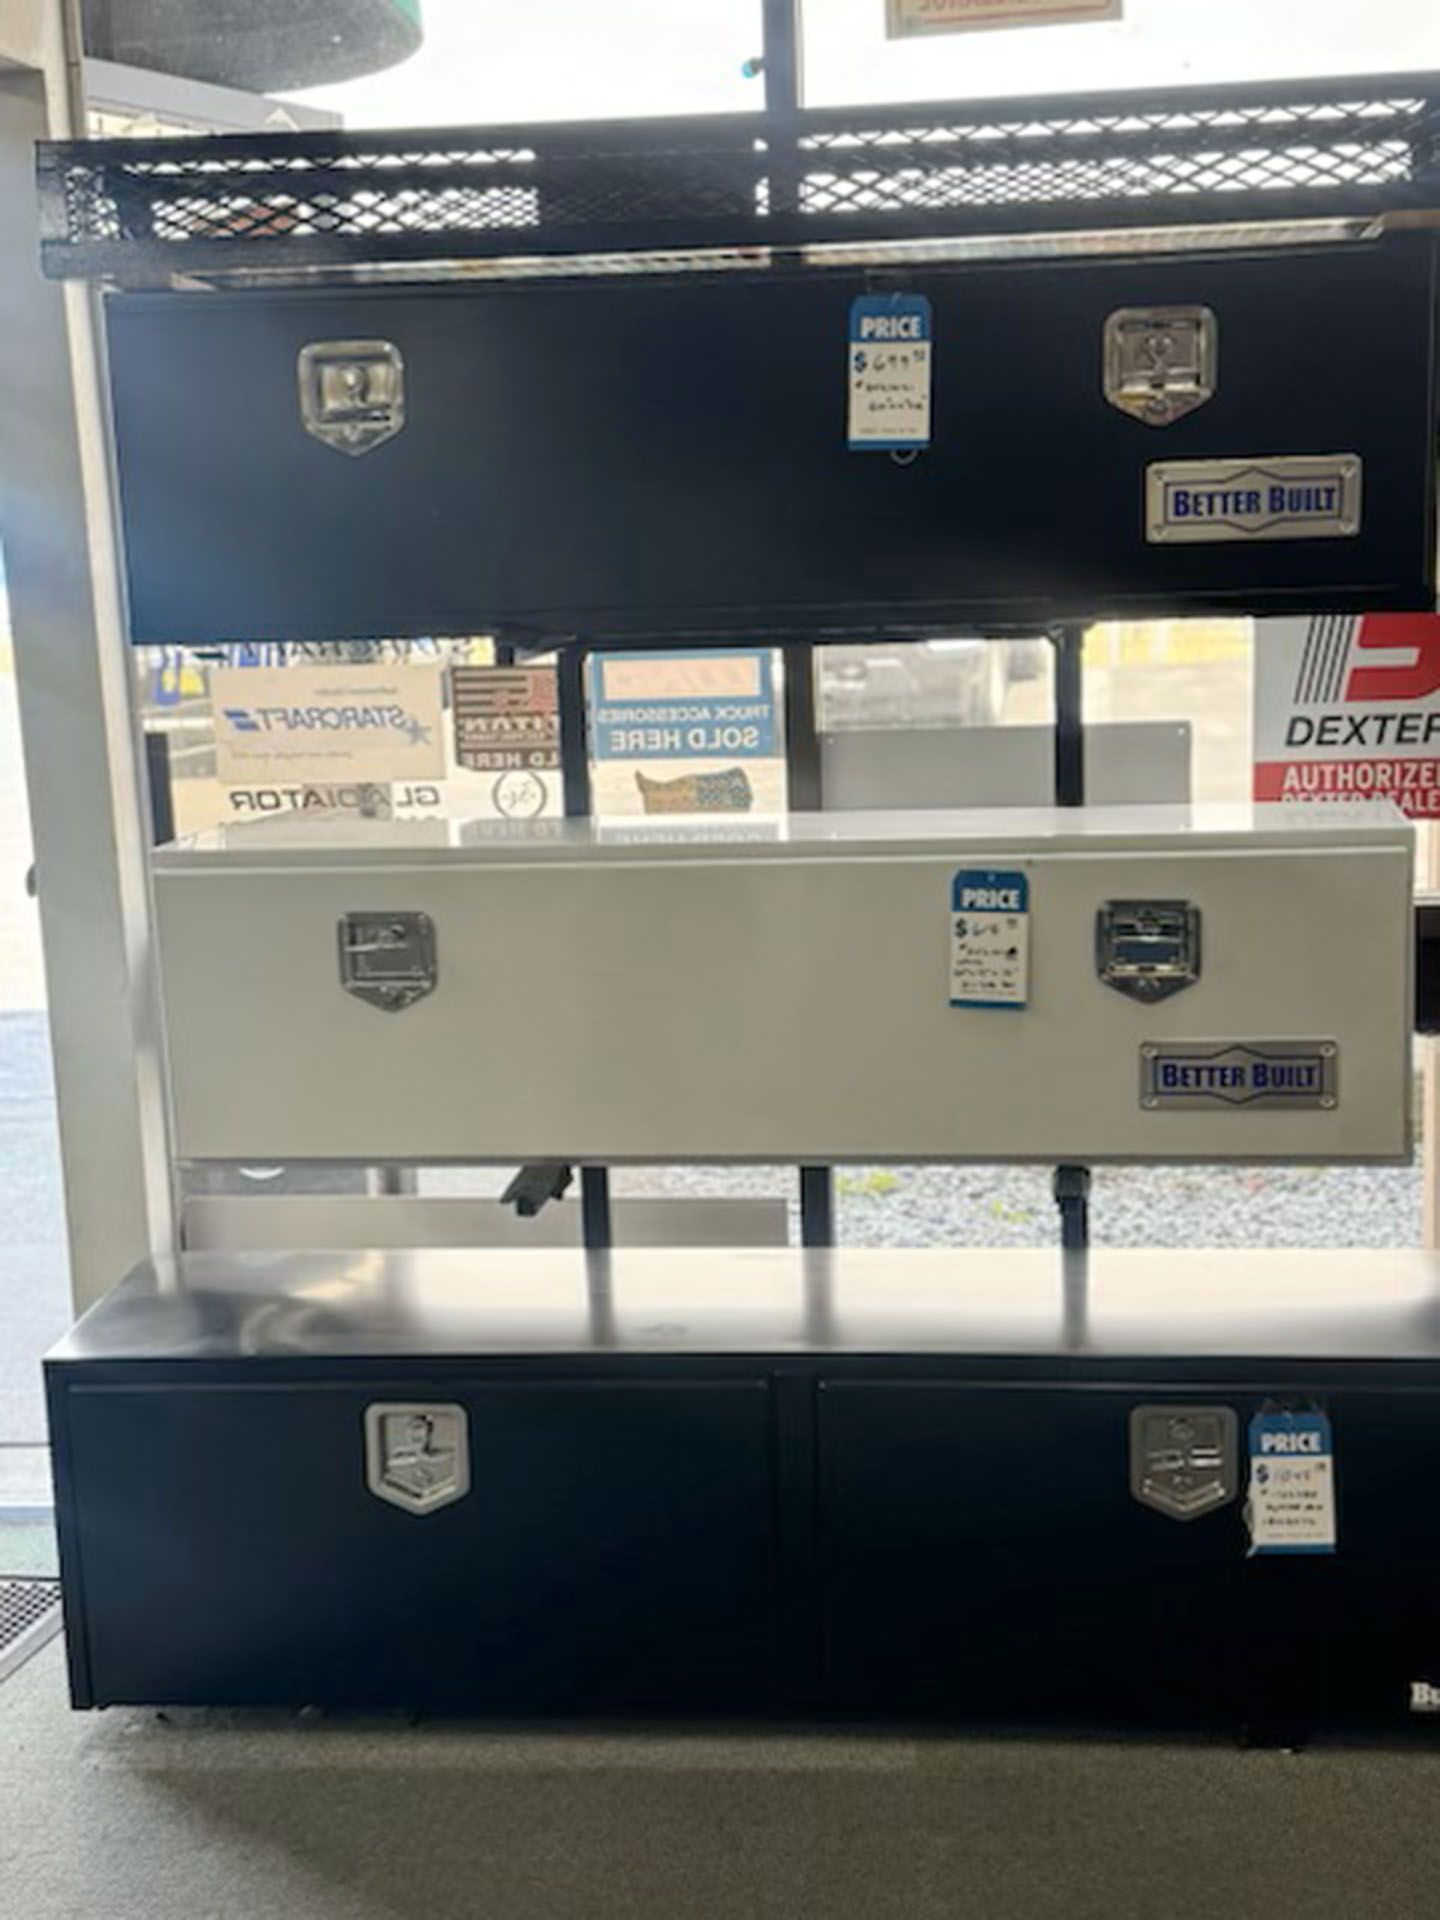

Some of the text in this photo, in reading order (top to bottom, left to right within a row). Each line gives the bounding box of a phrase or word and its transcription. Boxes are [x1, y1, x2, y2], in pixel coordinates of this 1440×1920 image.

[860, 316, 922, 338] PRICE
[1173, 486, 1336, 517] BETTER BUILT
[1283, 763, 1440, 790] AUTHORIZE
[961, 888, 1020, 909] PRICE
[1162, 1063, 1317, 1087] BETTER BUILT
[1260, 1432, 1321, 1453] PRICE
